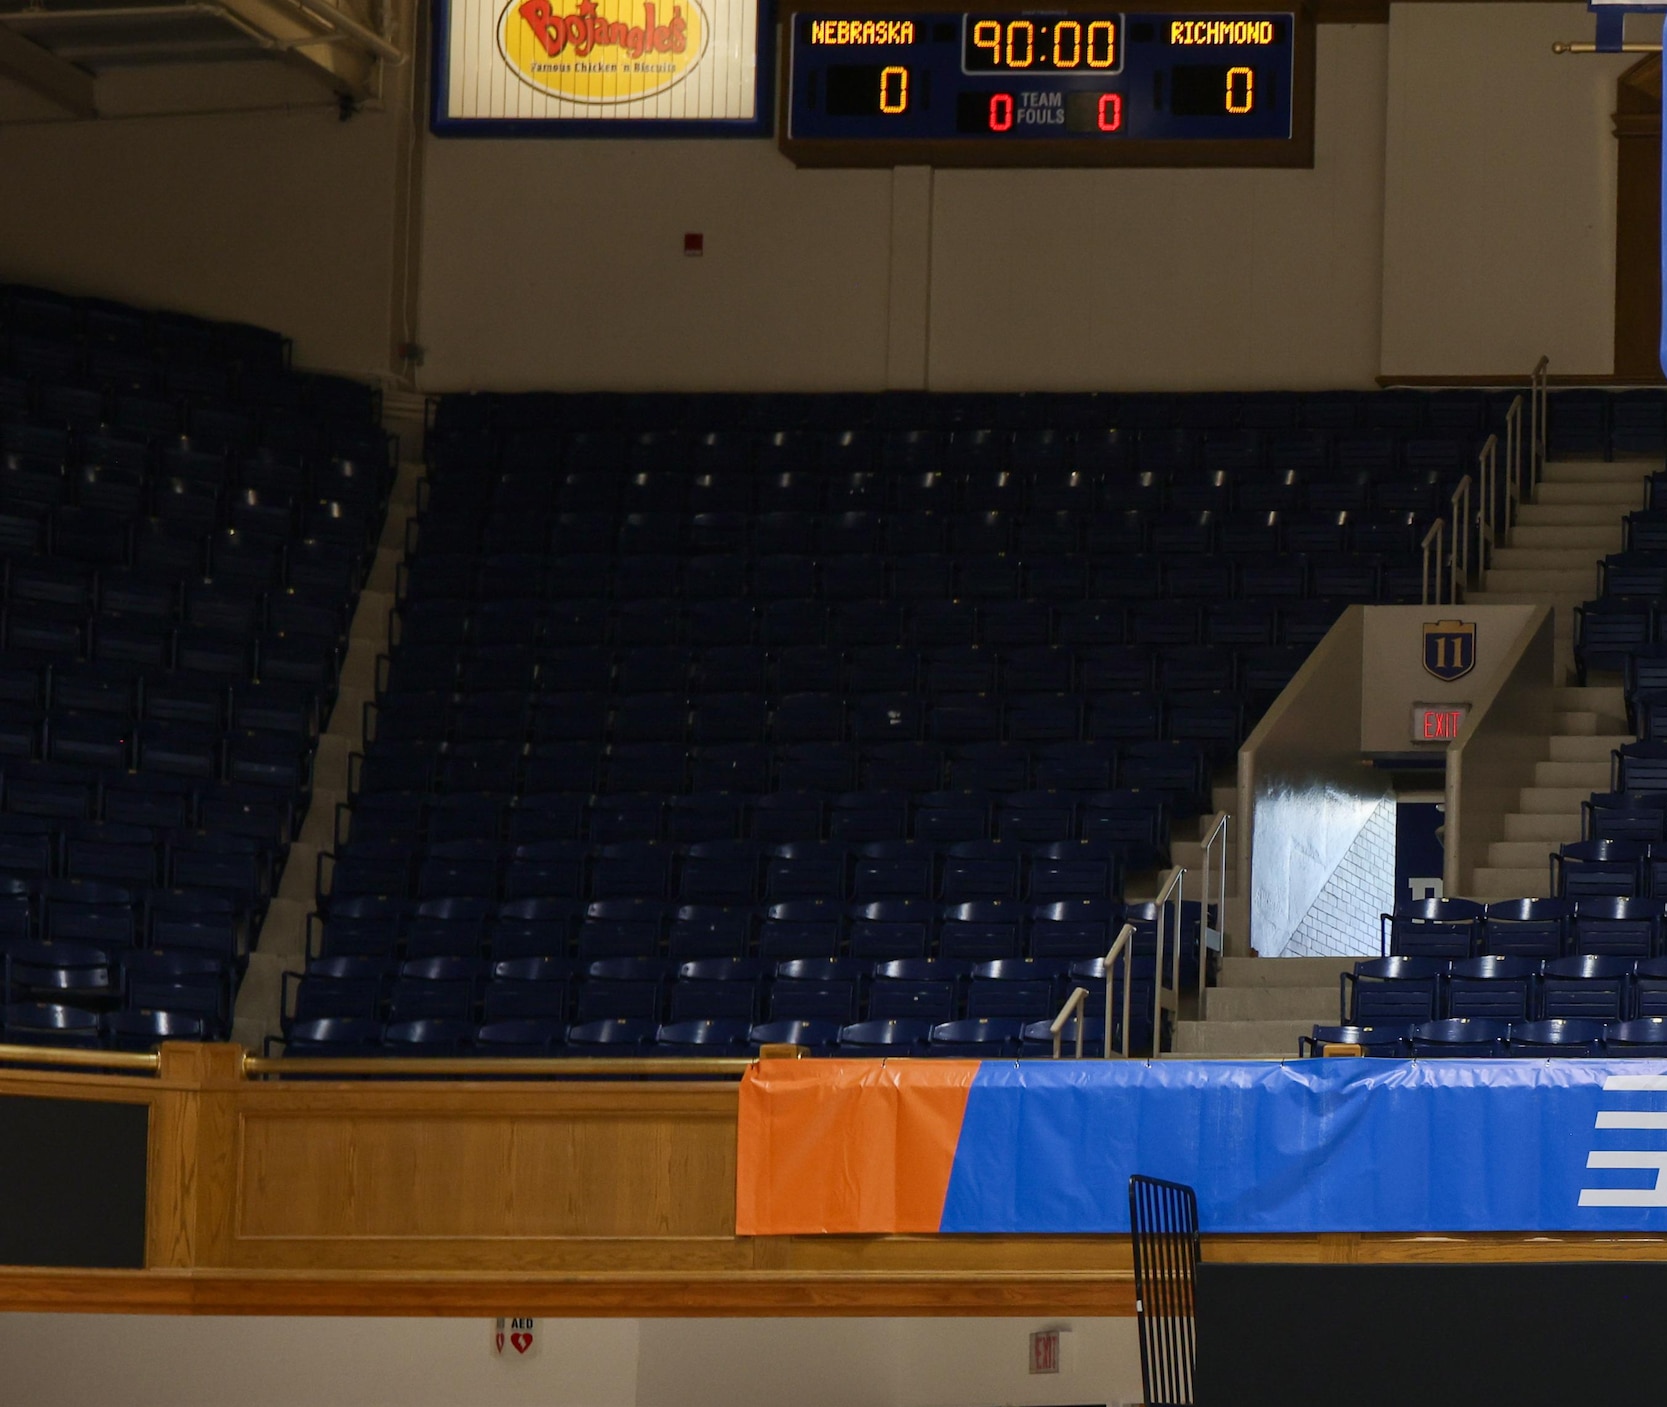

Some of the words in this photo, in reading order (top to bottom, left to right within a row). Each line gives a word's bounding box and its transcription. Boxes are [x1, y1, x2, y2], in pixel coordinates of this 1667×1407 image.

[811, 20, 915, 45] NEBRASKA
[973, 20, 1114, 68] 90:00
[1170, 20, 1273, 45] RICHMOND
[574, 62, 617, 73] Chicken
[879, 66, 909, 114] 0
[1020, 92, 1061, 107] TEAM
[1225, 66, 1254, 114] 0
[989, 93, 1013, 132] 0
[1017, 109, 1065, 124] FOULS
[1097, 93, 1122, 132] 0
[1435, 637, 1463, 668] 11
[1424, 711, 1461, 738] EXIT
